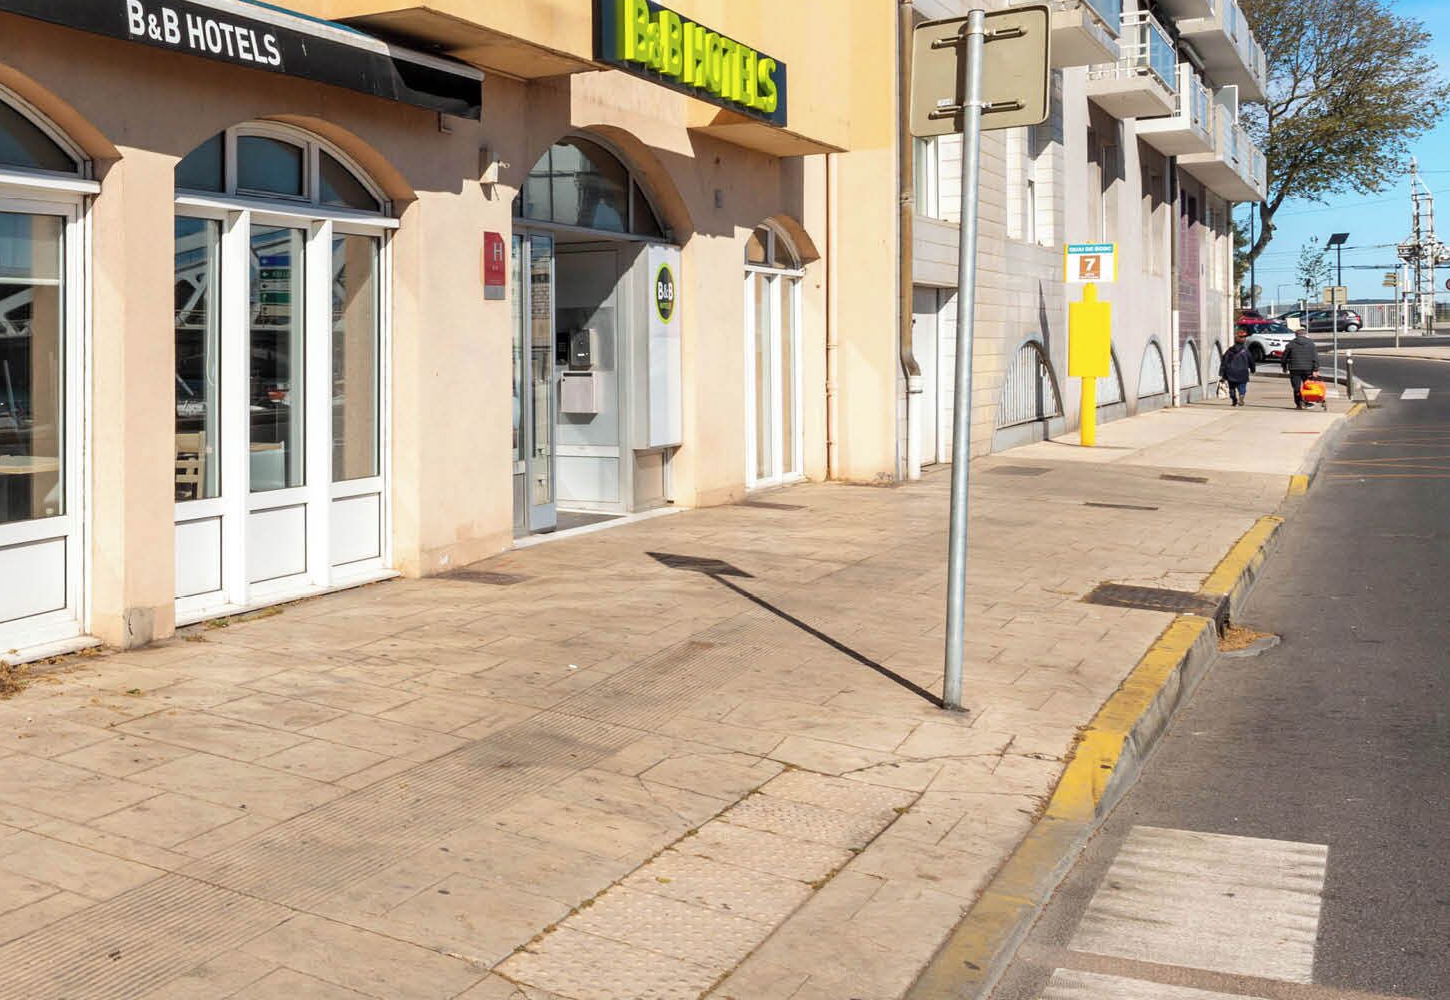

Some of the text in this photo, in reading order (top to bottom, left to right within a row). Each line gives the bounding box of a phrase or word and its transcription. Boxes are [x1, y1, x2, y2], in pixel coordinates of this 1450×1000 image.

[185, 13, 281, 66] HOTELS
[683, 21, 778, 113] HOTELS
[1084, 258, 1096, 271] 7
[657, 281, 673, 301] B&B
